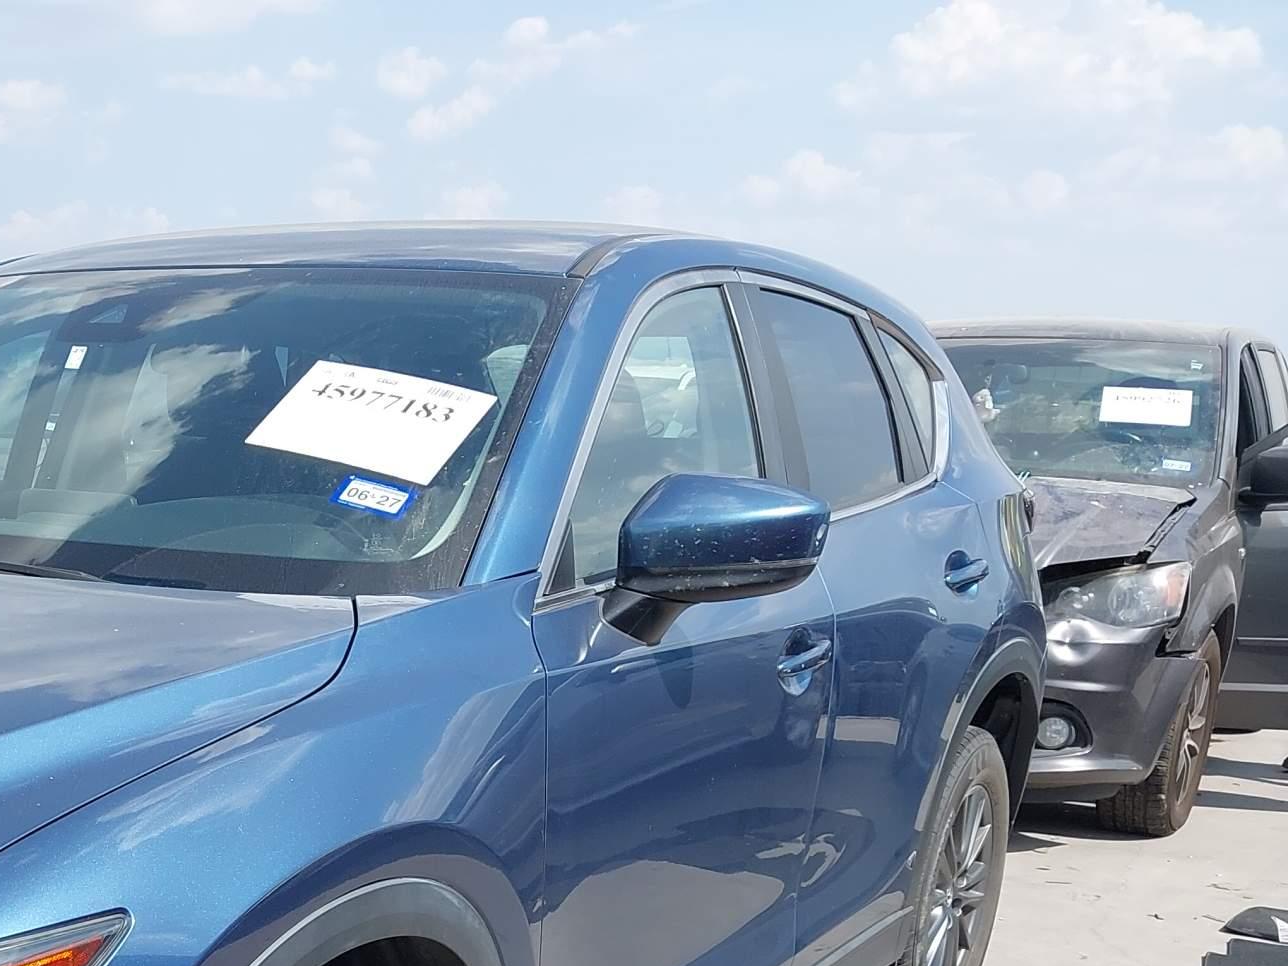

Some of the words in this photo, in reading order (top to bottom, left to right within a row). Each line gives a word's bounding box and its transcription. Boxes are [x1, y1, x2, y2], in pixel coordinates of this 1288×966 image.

[312, 383, 455, 422] 45977183
[346, 487, 370, 501] 06
[376, 495, 402, 508] 27
